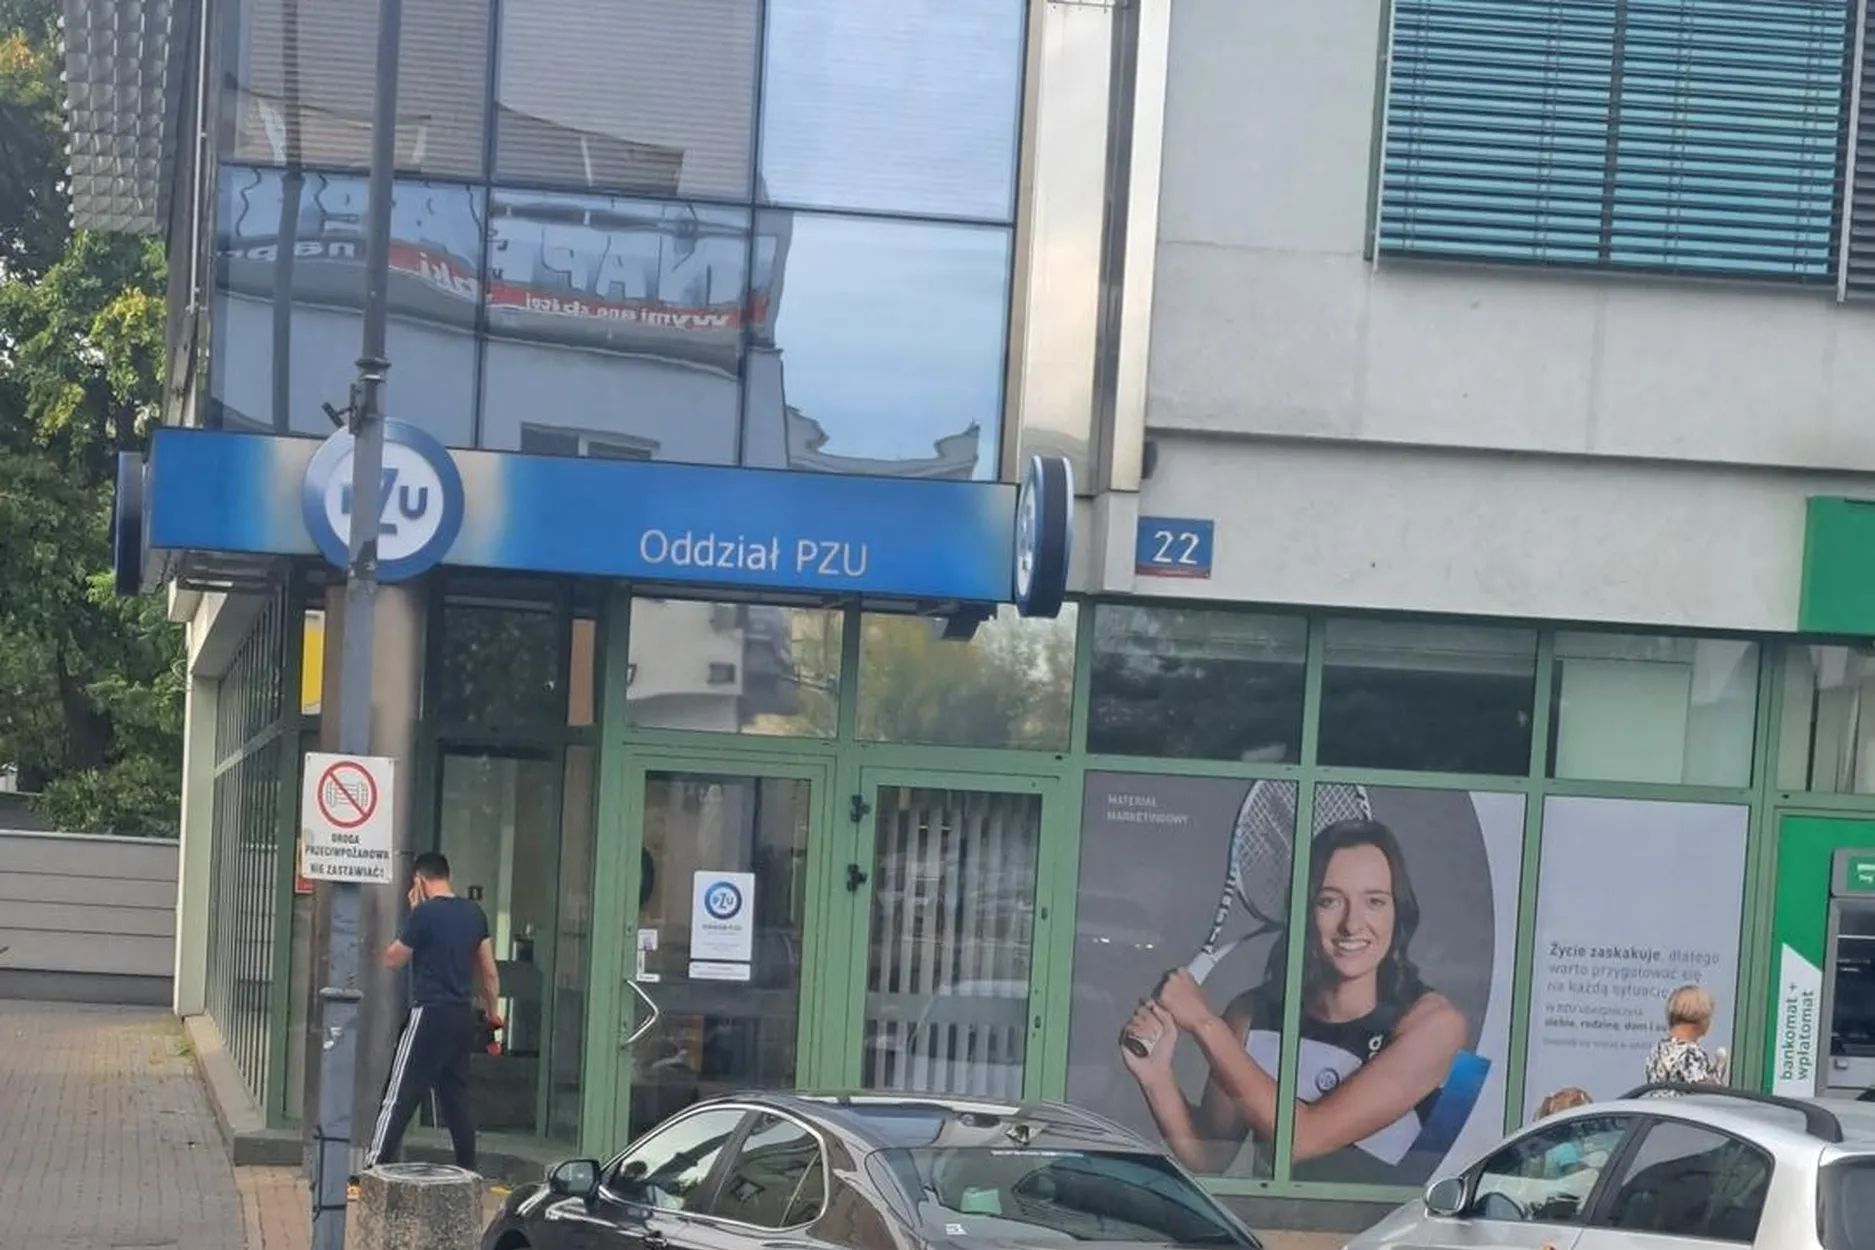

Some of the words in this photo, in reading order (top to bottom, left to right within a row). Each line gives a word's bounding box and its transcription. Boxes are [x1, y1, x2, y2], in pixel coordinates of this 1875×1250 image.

[639, 528, 781, 571] Oddział
[796, 538, 868, 577] PZU
[1152, 530, 1200, 565] 22
[331, 833, 360, 845] DROGA
[309, 863, 324, 874] NIE
[1781, 995, 1798, 1081] bankomat
[1798, 990, 1815, 1081] wpłatomat
